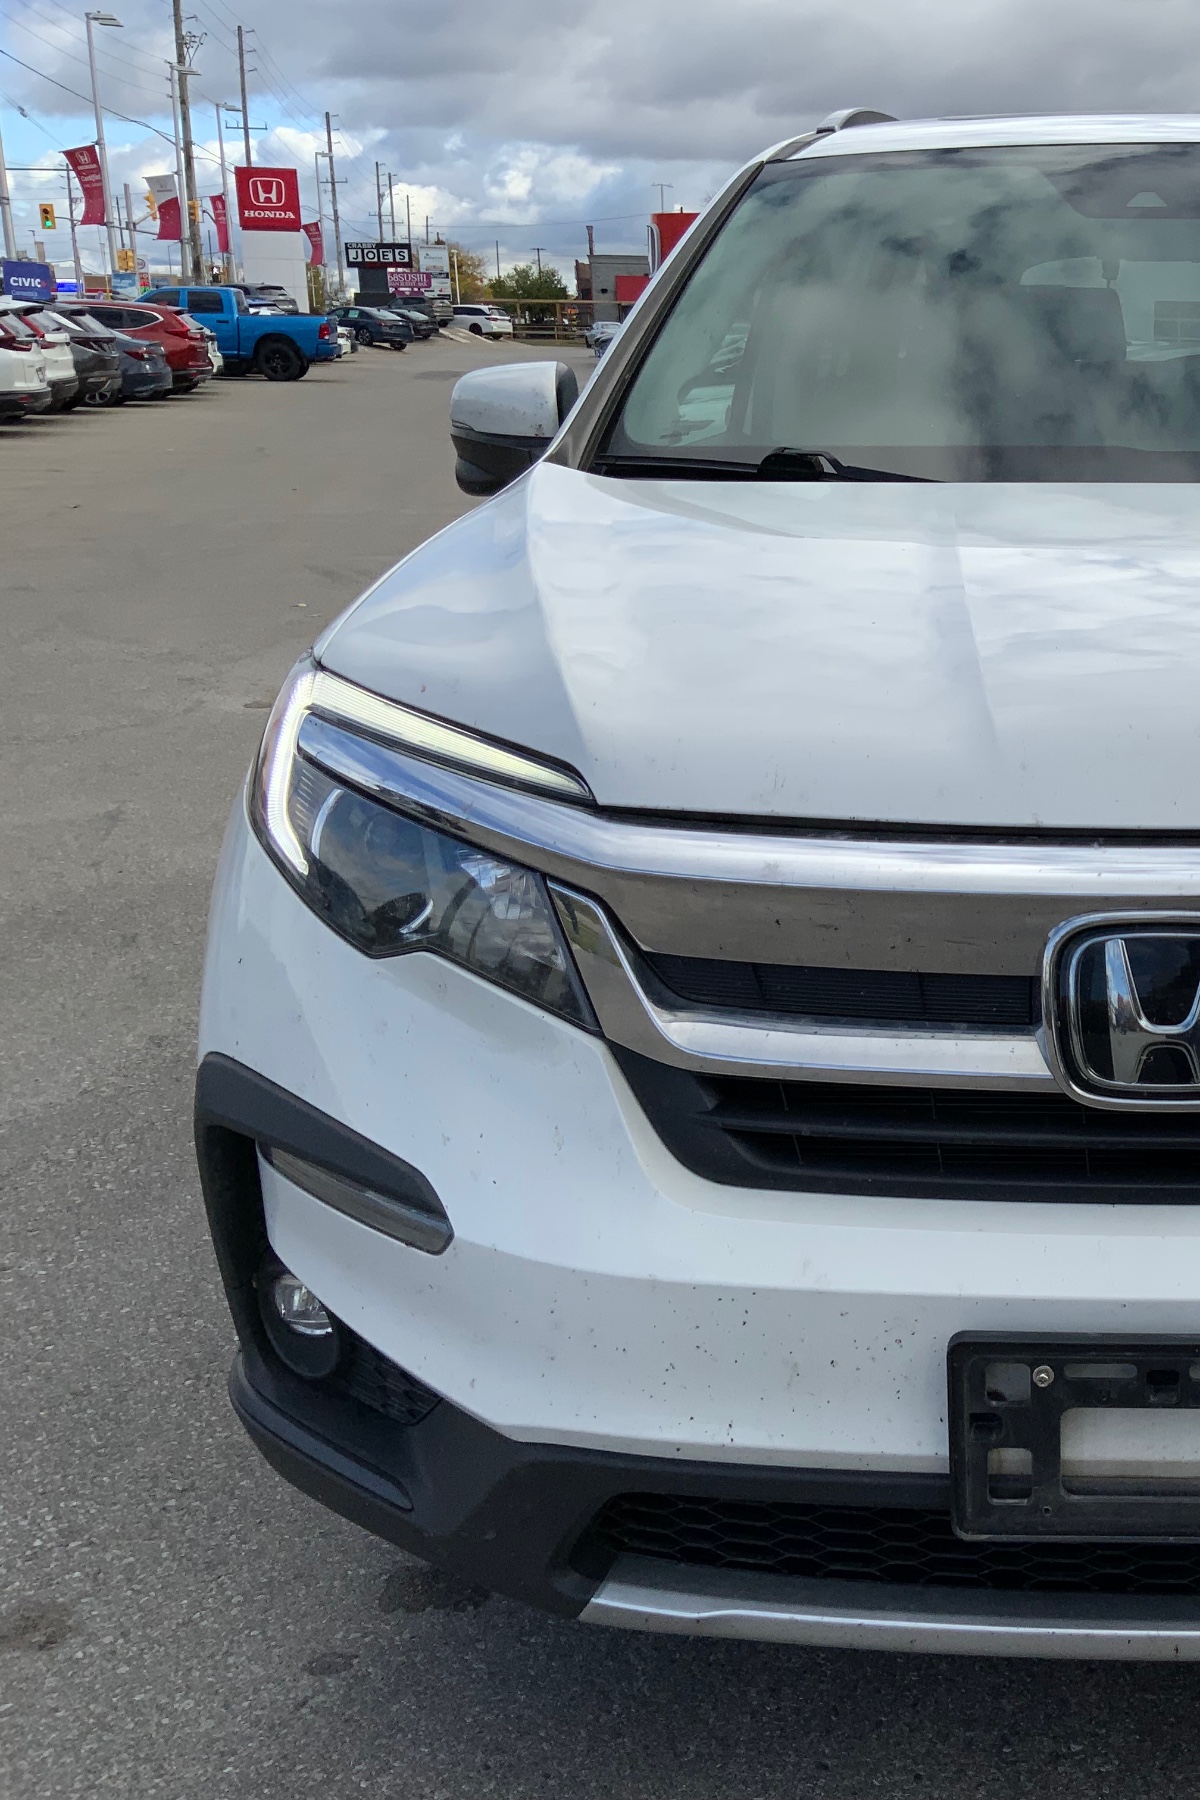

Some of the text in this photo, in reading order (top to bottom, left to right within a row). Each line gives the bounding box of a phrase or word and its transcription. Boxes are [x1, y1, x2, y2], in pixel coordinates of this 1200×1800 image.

[244, 210, 295, 219] HONDA
[352, 250, 406, 260] JOE'S
[10, 276, 42, 288] CIVIC
